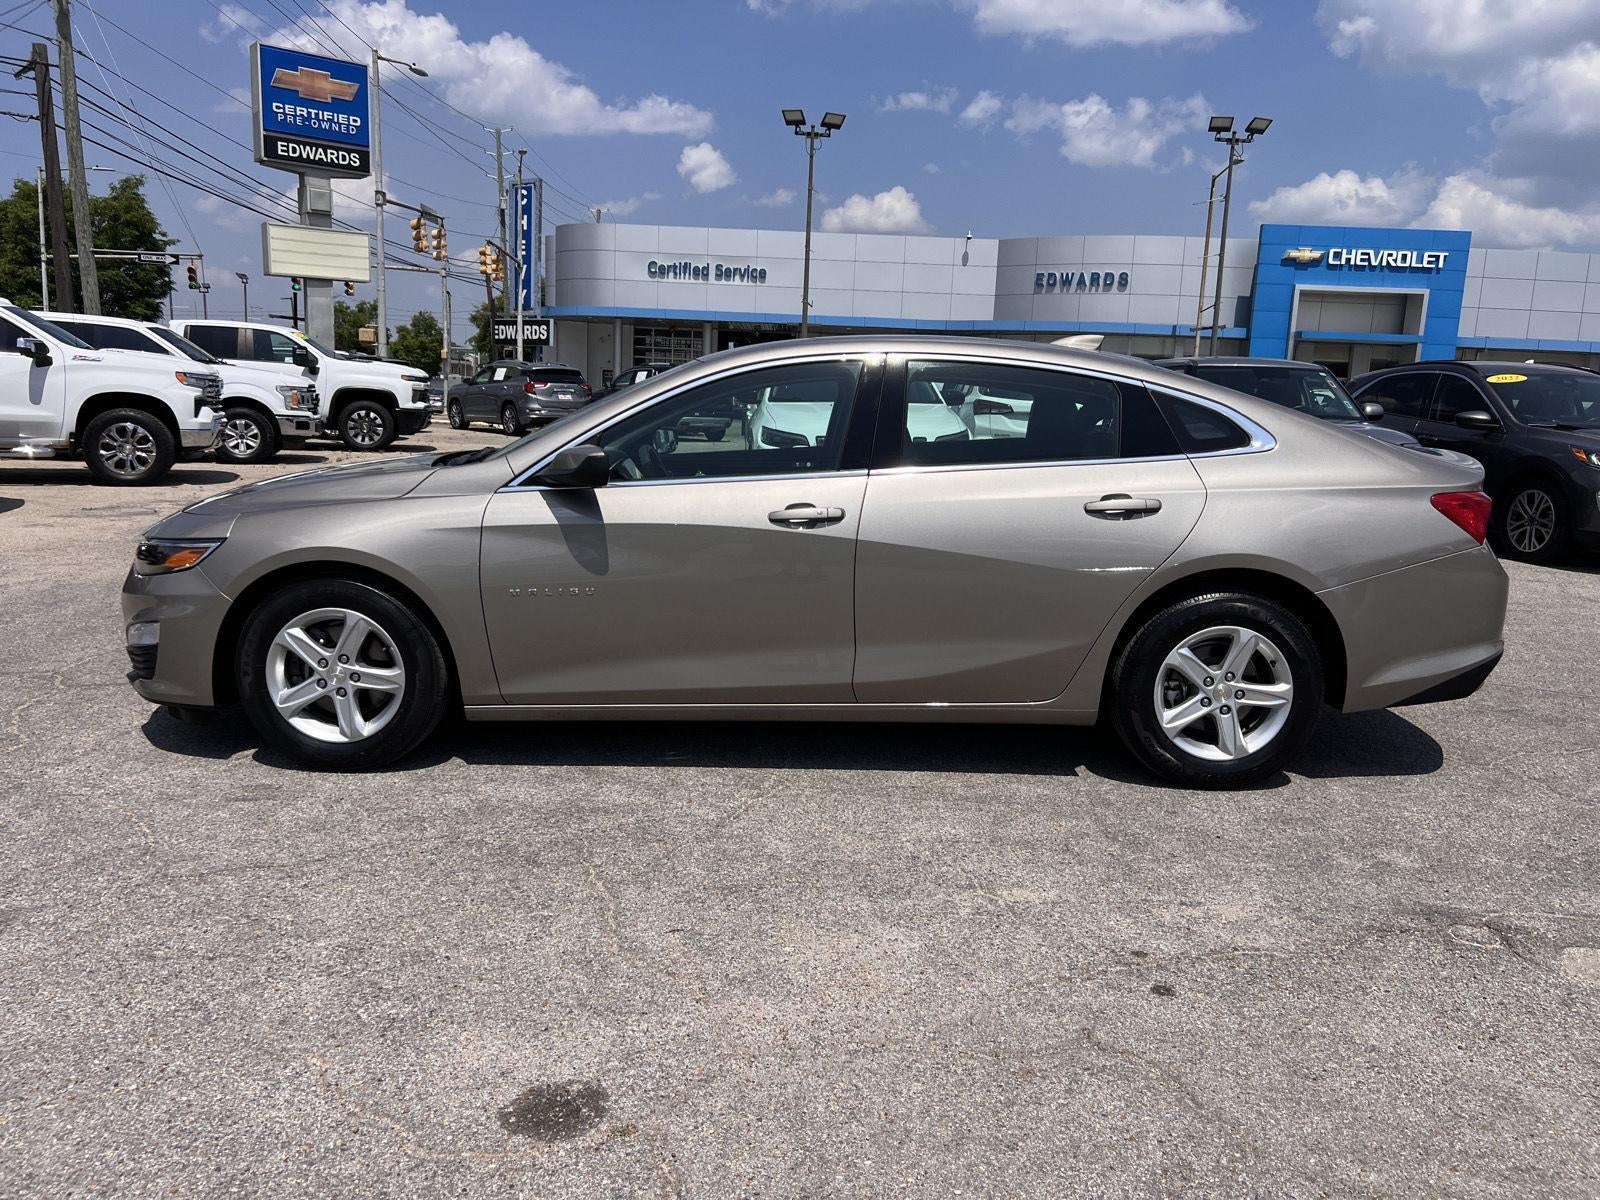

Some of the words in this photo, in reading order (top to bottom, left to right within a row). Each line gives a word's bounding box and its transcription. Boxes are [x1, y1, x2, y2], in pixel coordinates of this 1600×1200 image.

[272, 102, 361, 127] CERTIFIED
[277, 113, 356, 134] PRE-OWNED
[277, 141, 361, 167] EDWARDS
[1328, 249, 1449, 269] CHEVROLET
[647, 260, 710, 281] Certified
[714, 263, 767, 284] Service
[1035, 271, 1128, 291] EDWARDS
[509, 587, 595, 597] MALIBU
